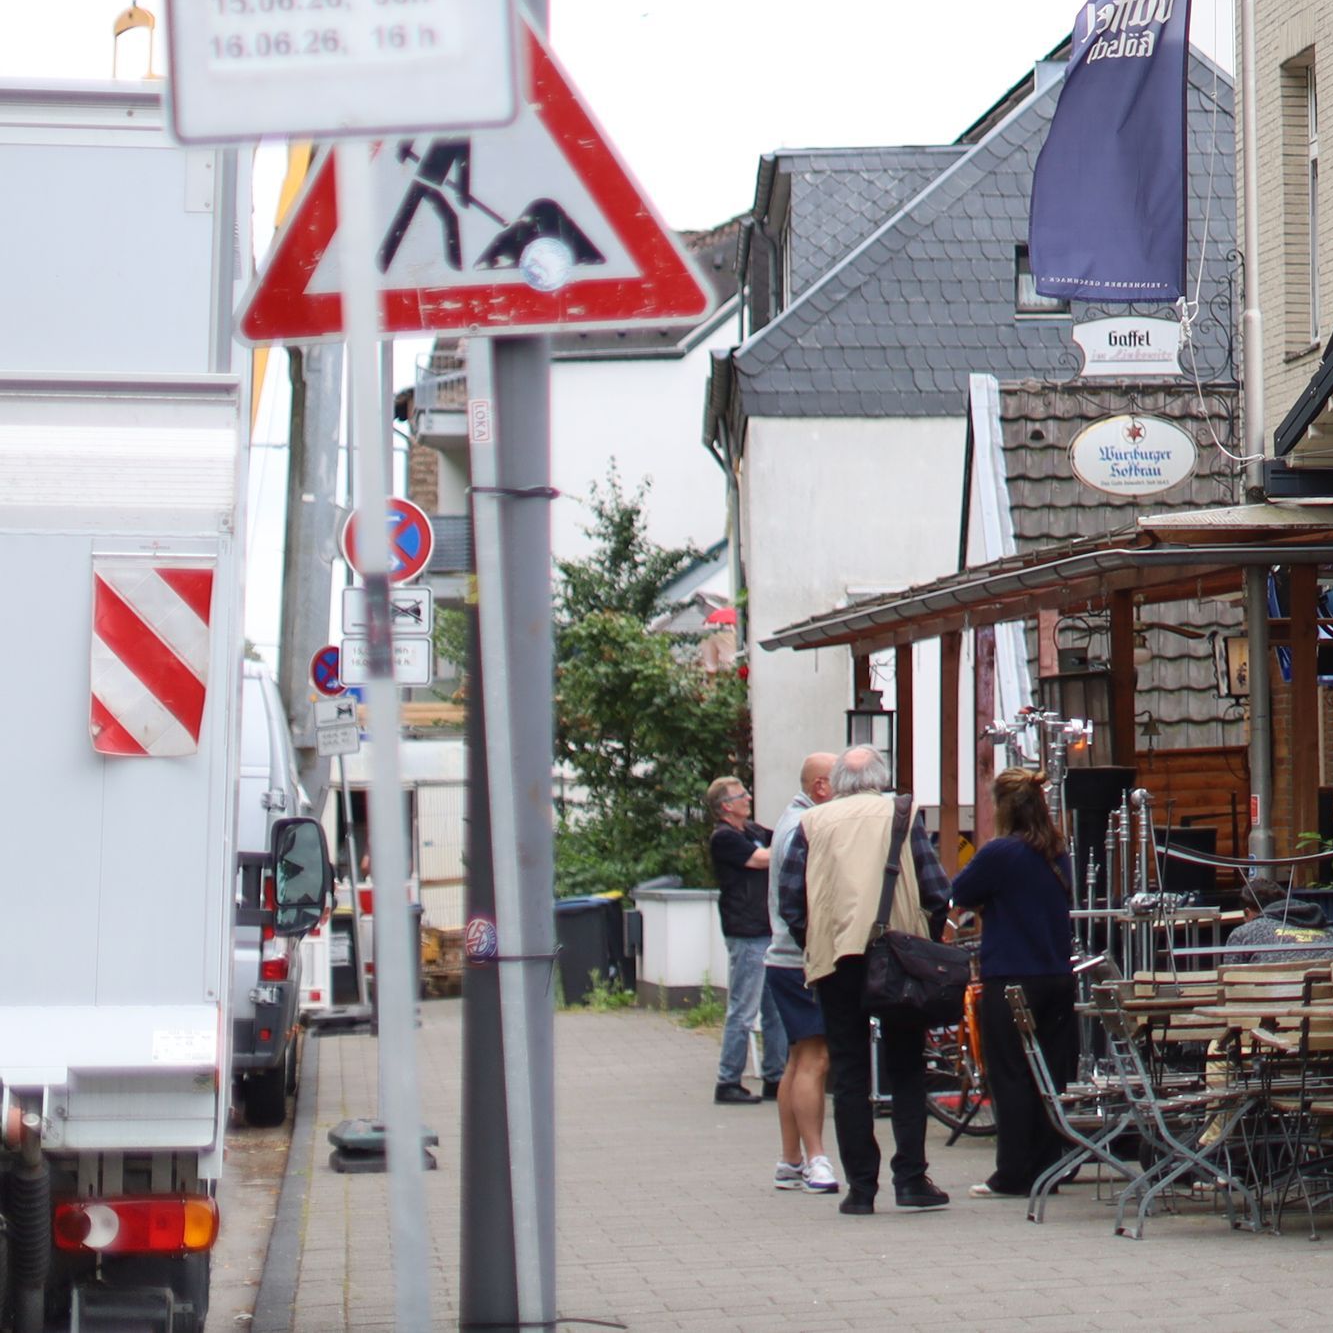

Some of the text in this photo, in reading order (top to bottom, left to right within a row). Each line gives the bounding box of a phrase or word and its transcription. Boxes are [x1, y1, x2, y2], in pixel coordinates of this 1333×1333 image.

[371, 24, 406, 50] 16
[416, 22, 437, 48] h
[1108, 329, 1152, 347] Gaffel
